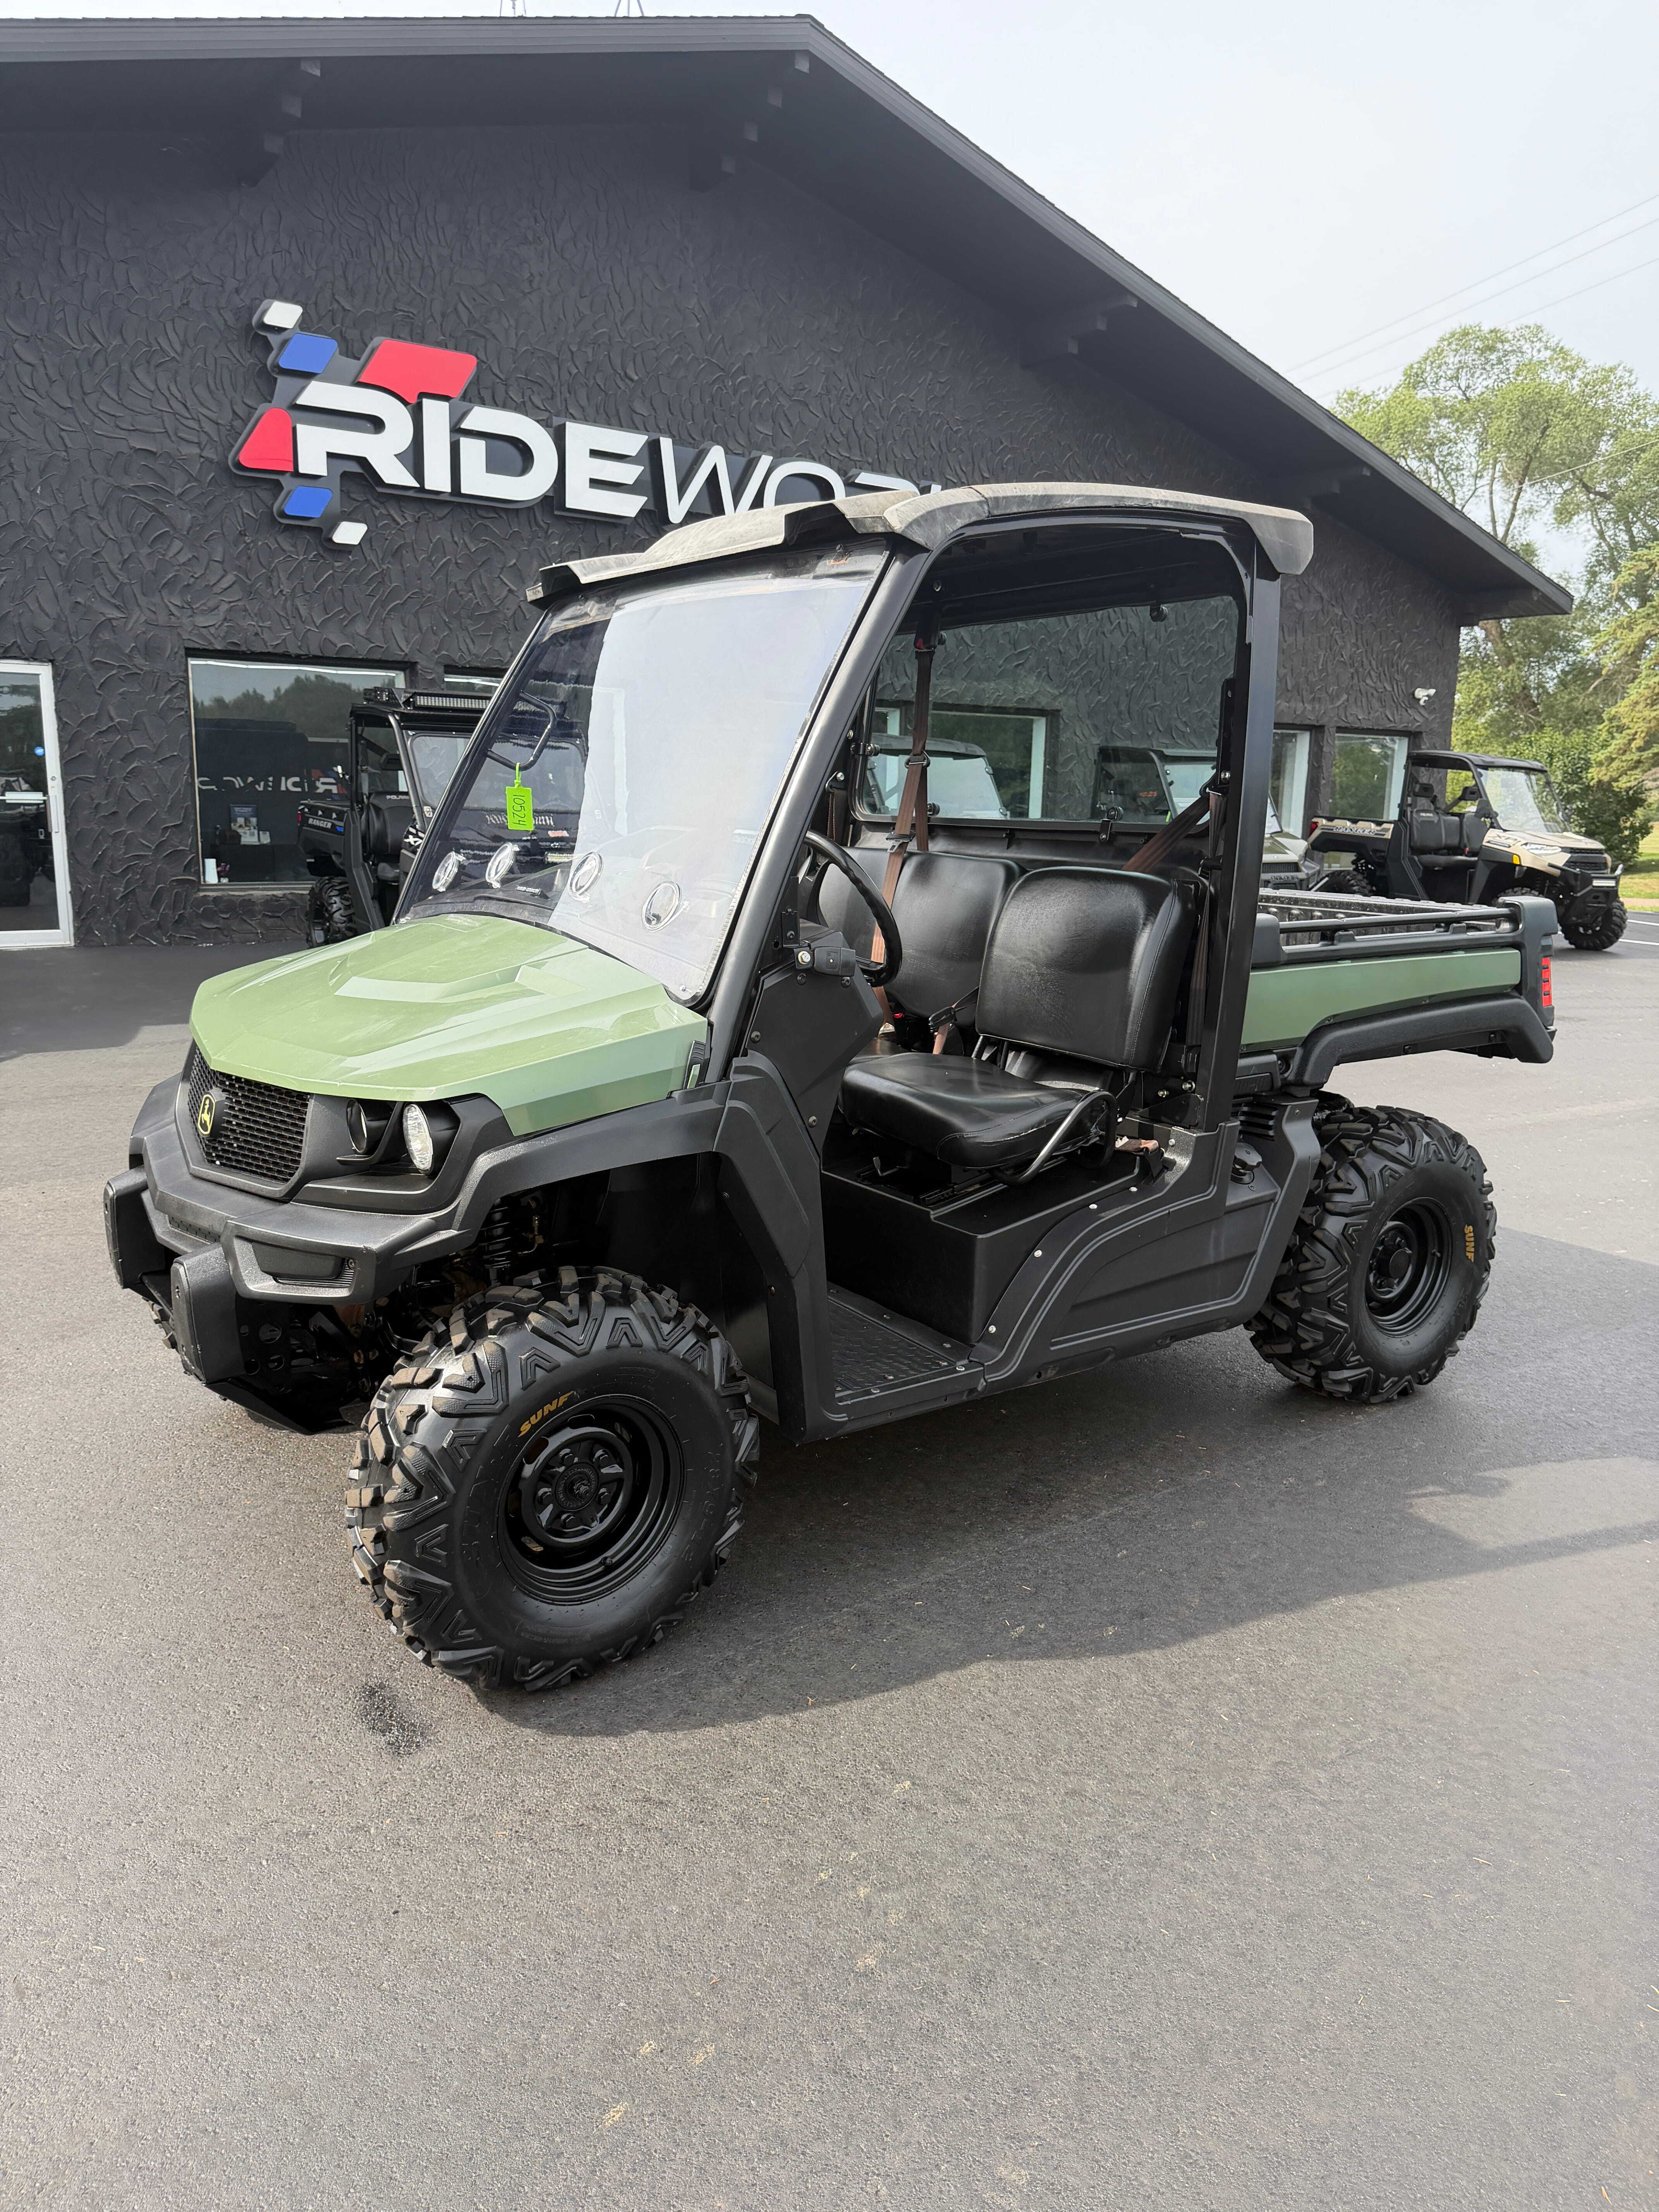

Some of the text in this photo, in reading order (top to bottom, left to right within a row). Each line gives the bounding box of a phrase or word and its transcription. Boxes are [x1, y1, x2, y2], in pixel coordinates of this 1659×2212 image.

[308, 817, 332, 829] RANGER
[512, 794, 527, 826] 10524
[1464, 1224, 1474, 1262] SUNF
[517, 1391, 574, 1438] SUNF
